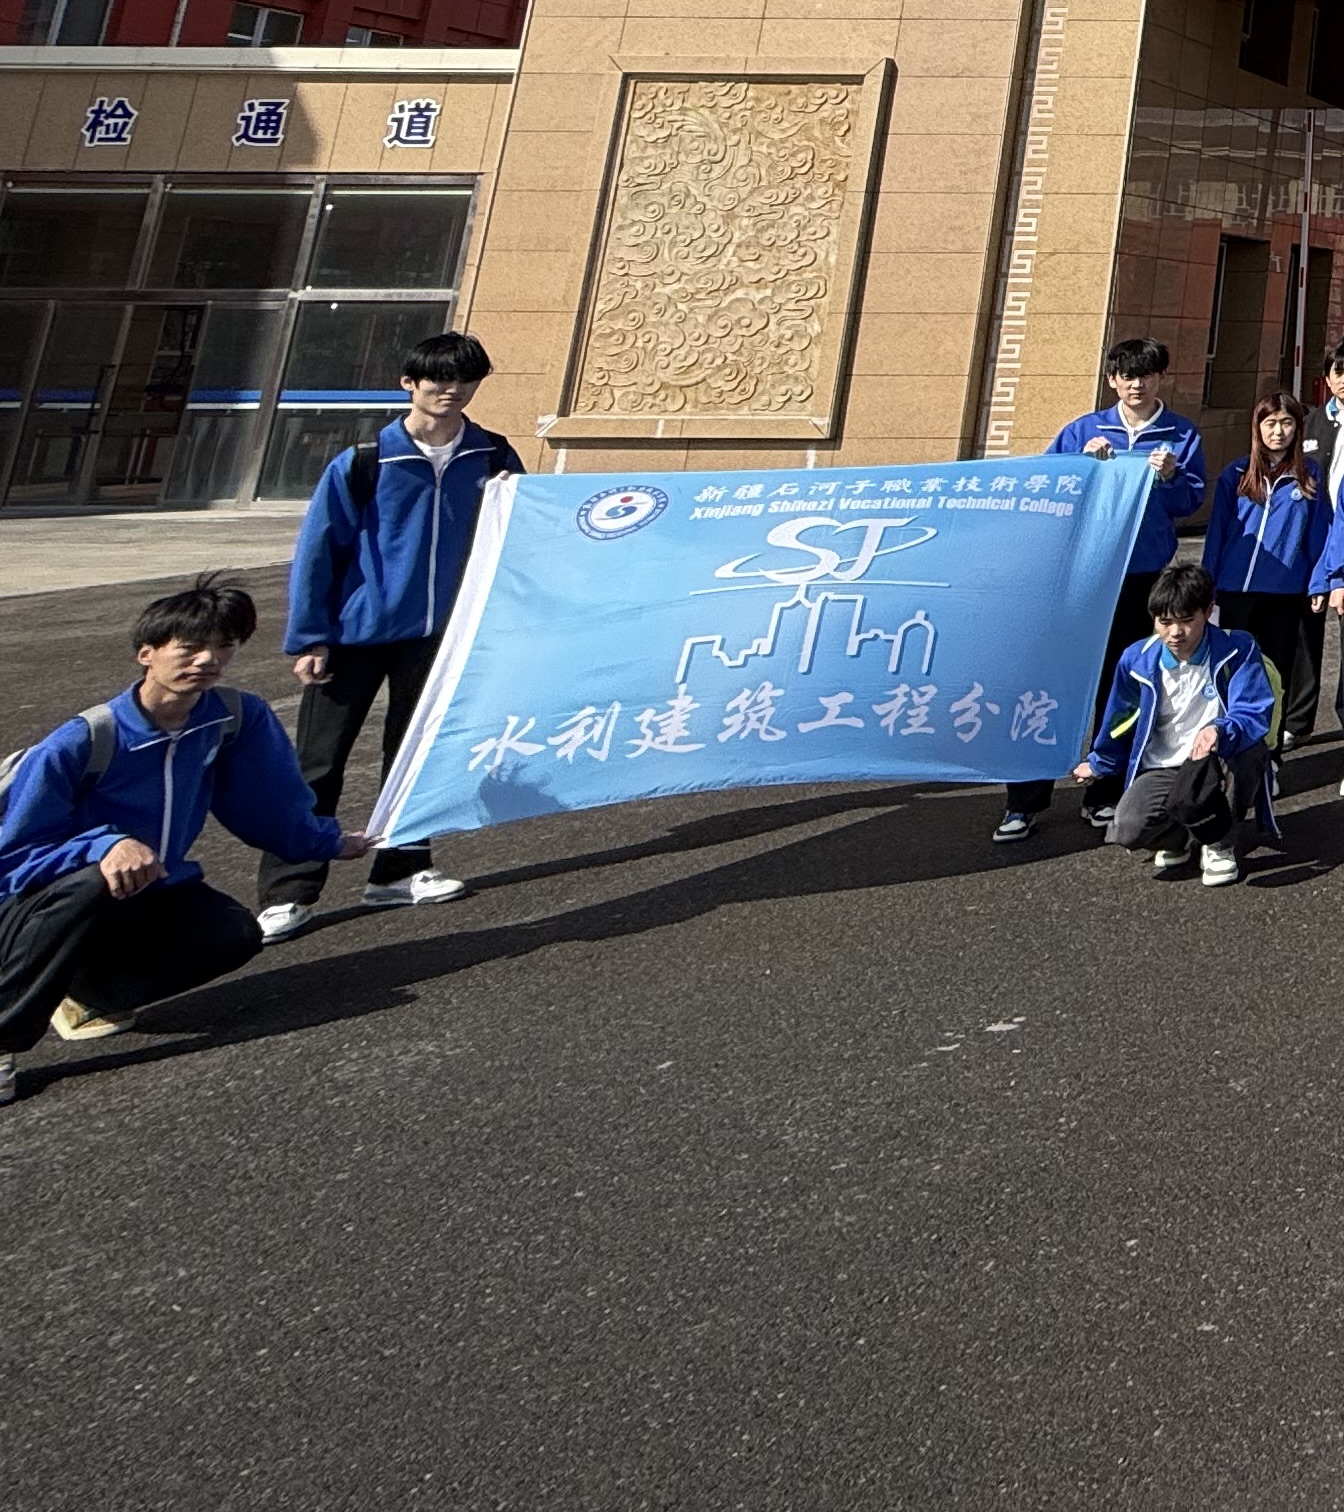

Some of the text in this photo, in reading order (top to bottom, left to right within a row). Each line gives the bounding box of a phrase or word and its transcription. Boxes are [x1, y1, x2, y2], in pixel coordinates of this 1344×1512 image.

[81, 97, 438, 148] 检通道
[689, 496, 1075, 521] Xinjiang Shihezi Vocational Technical College
[467, 681, 1058, 772] 水利建筑工程分院
